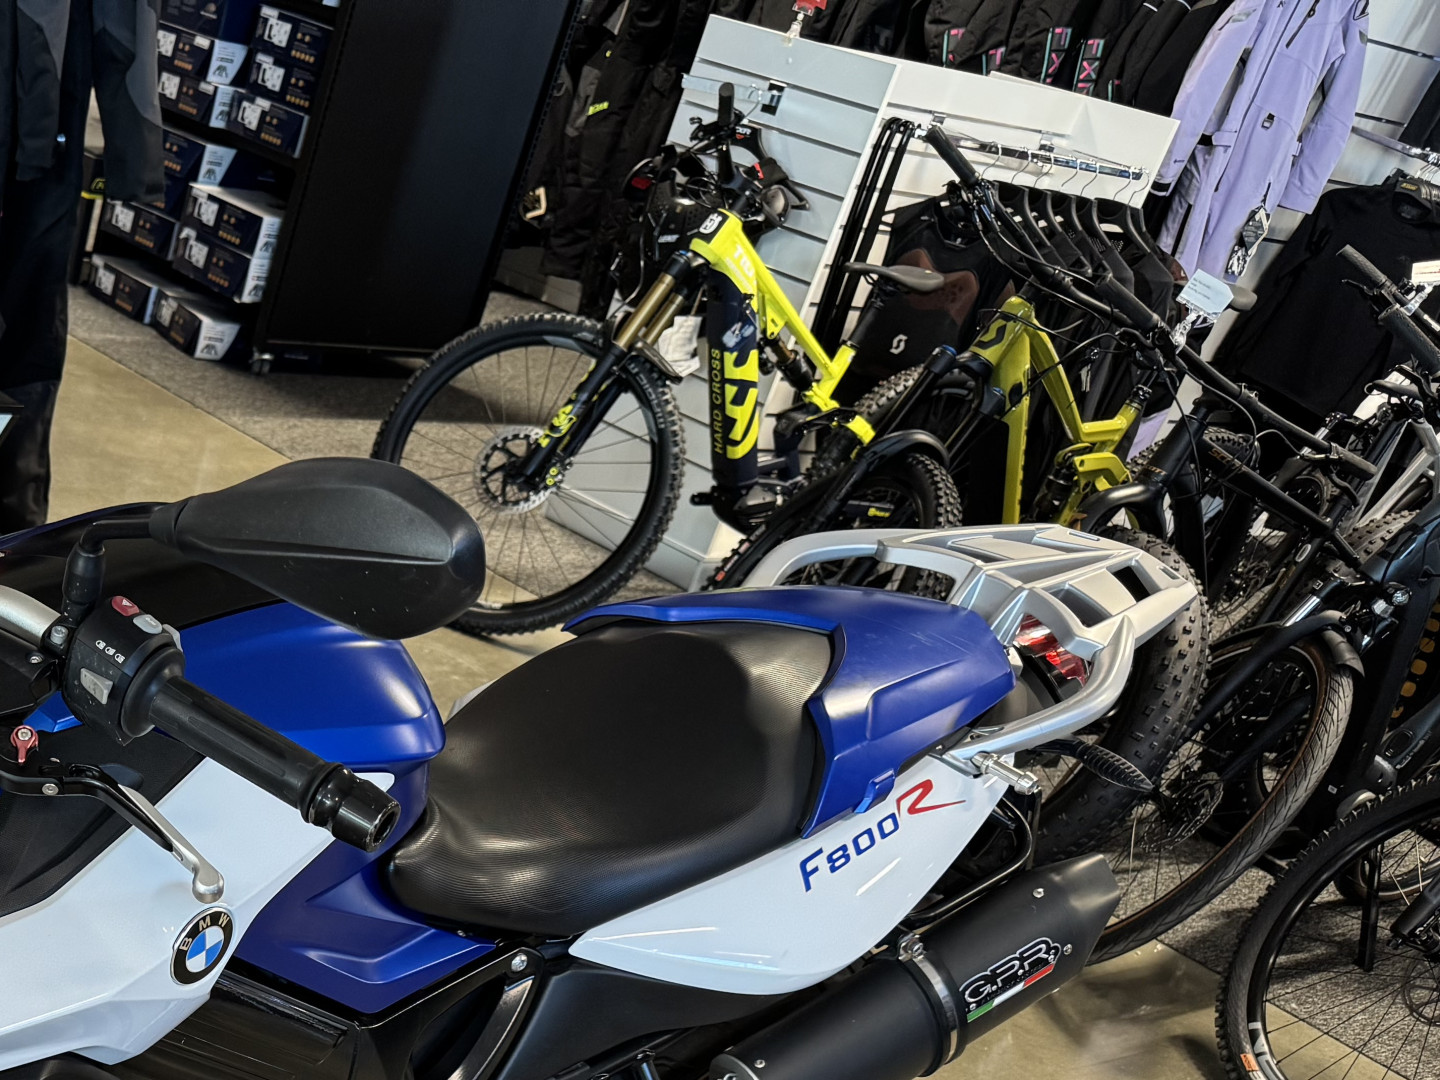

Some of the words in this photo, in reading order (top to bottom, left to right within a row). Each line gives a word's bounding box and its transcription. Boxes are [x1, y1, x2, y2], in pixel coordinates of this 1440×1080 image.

[711, 348, 723, 405] CROSS
[712, 410, 724, 454] HARD
[179, 912, 231, 951] BMW
